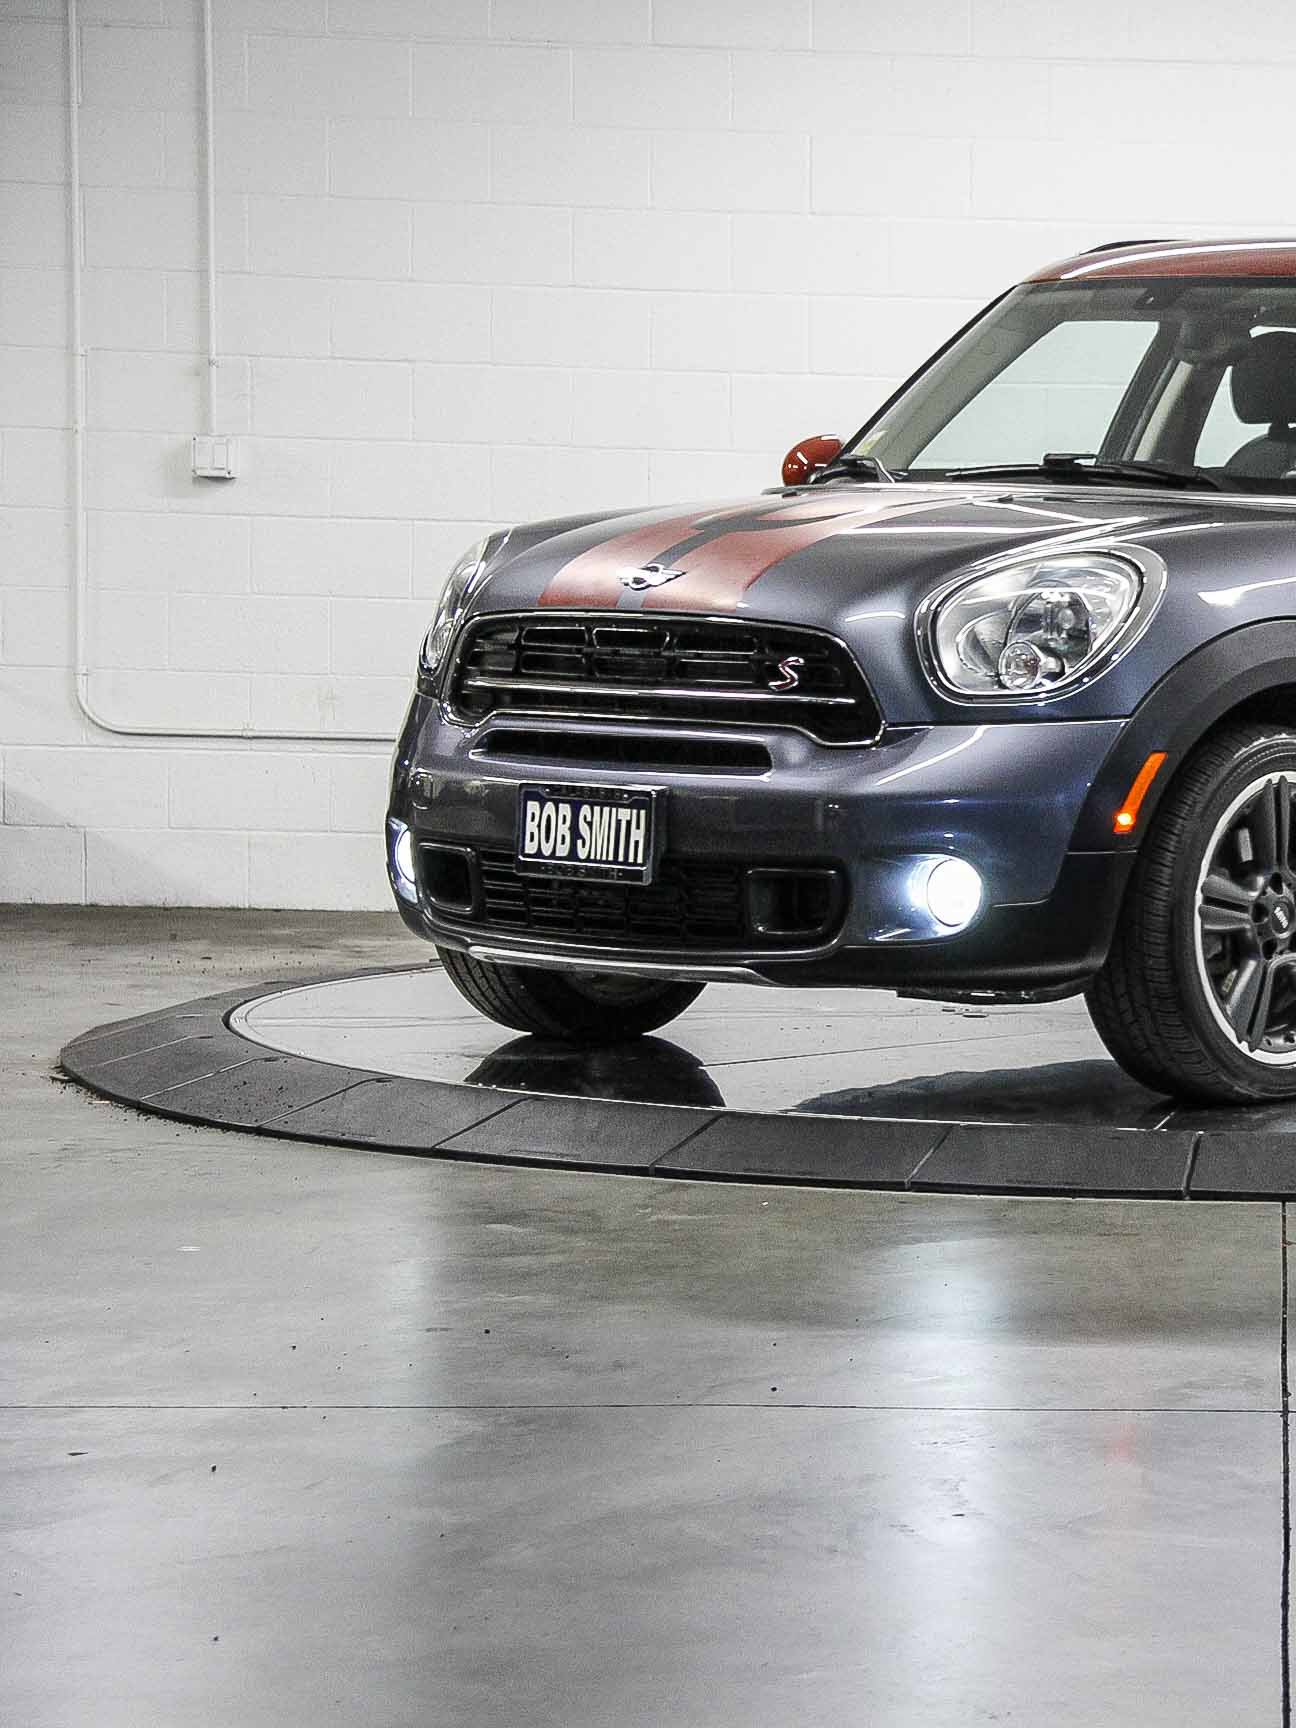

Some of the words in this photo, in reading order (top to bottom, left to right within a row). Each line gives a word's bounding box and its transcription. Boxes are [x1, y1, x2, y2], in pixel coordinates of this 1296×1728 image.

[768, 656, 804, 691] S
[524, 800, 572, 857] BOB
[576, 804, 646, 864] SMITH
